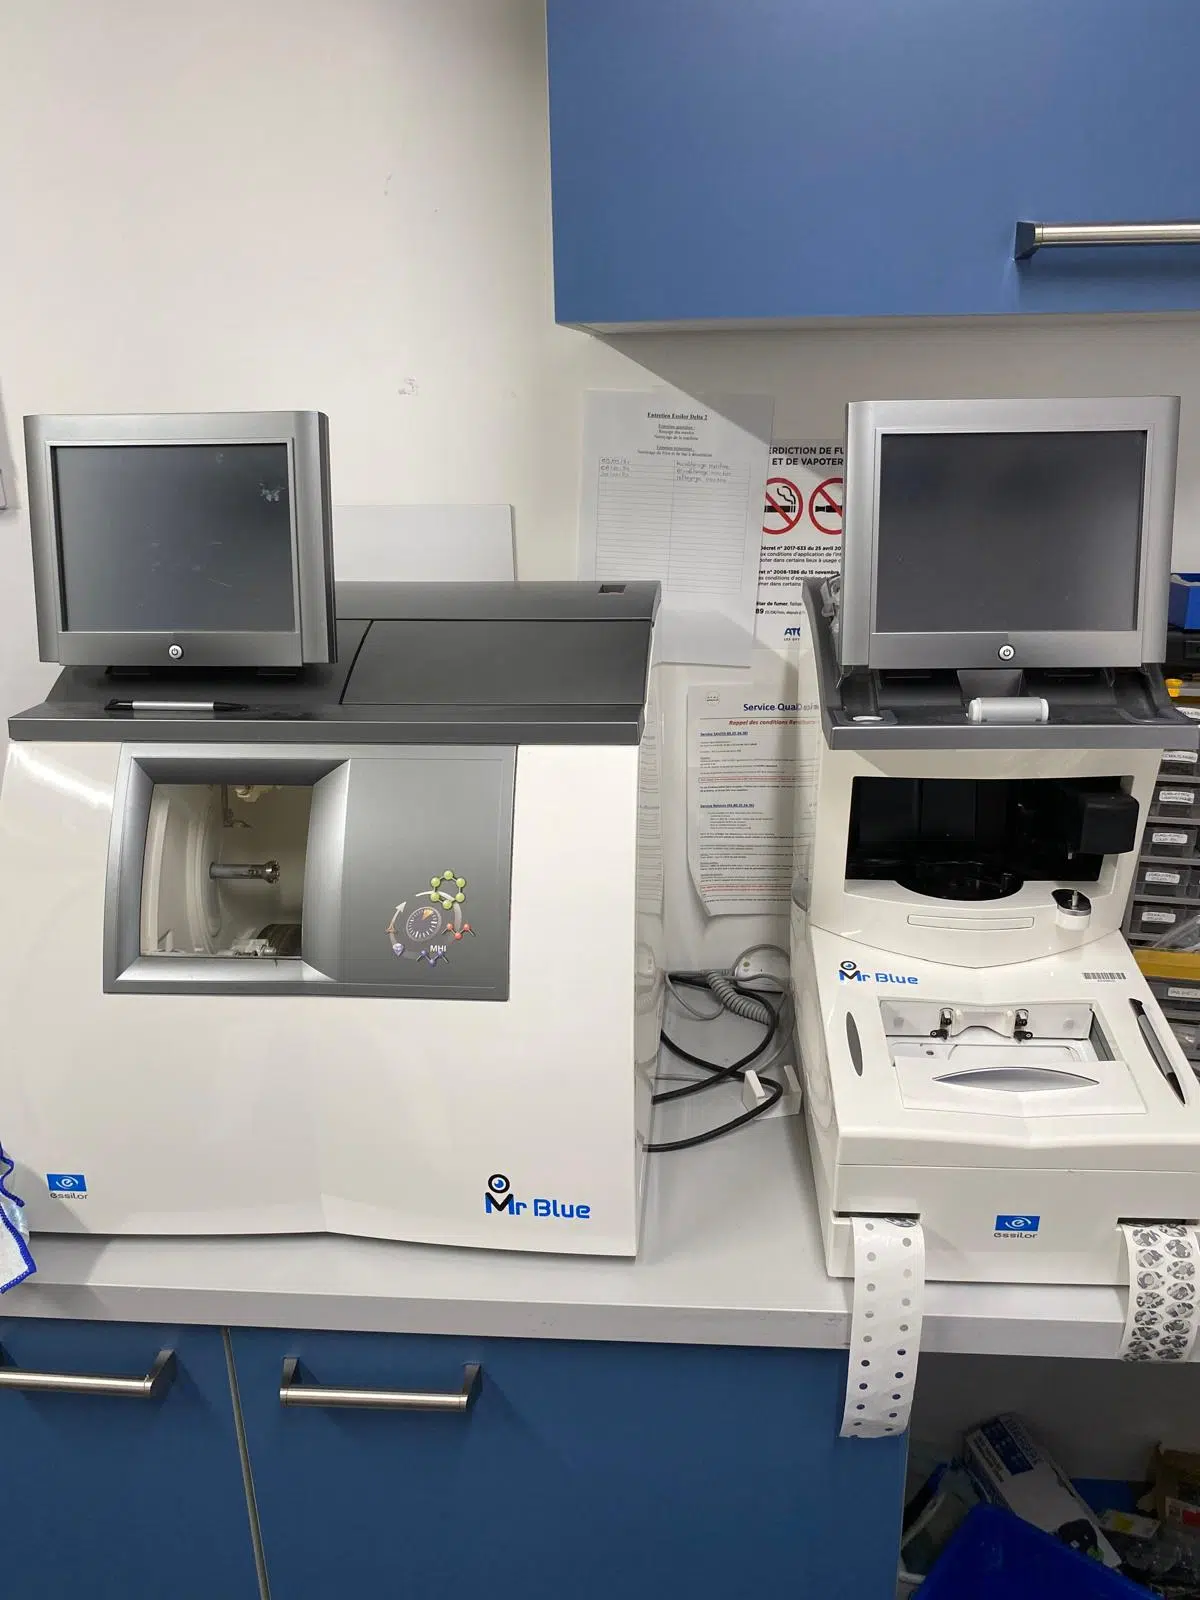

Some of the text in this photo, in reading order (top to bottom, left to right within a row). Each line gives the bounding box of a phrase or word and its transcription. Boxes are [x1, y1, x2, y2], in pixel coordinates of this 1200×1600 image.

[820, 447, 831, 455] DE
[772, 458, 844, 466] ET DE VAPOTER
[743, 703, 776, 711] Service
[430, 944, 447, 953] MHI
[838, 969, 918, 985] Mr Blue
[484, 1191, 591, 1219] Mr Blue
